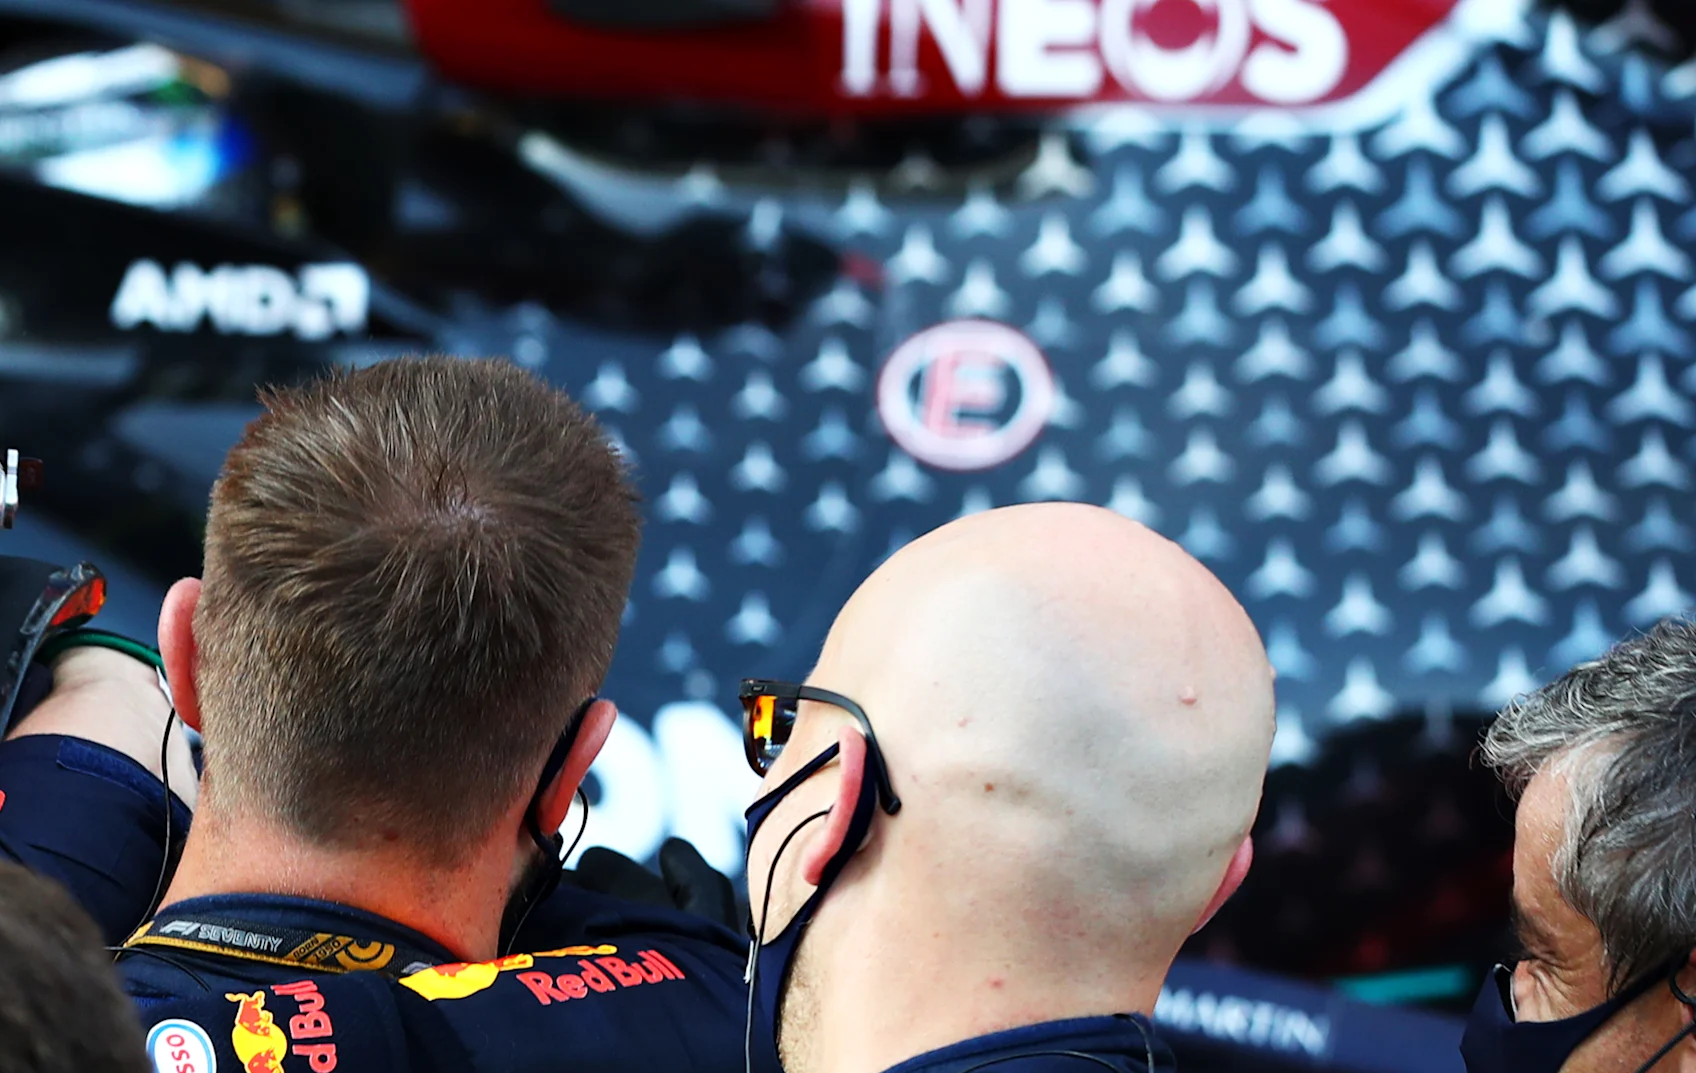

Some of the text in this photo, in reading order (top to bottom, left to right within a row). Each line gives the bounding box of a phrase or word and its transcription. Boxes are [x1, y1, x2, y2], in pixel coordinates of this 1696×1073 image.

[842, 0, 1349, 102] INEOS
[110, 256, 300, 335] AMD
[198, 924, 283, 952] SEVENTY
[516, 949, 686, 1006] Red Bull
[270, 979, 333, 1039] Bull
